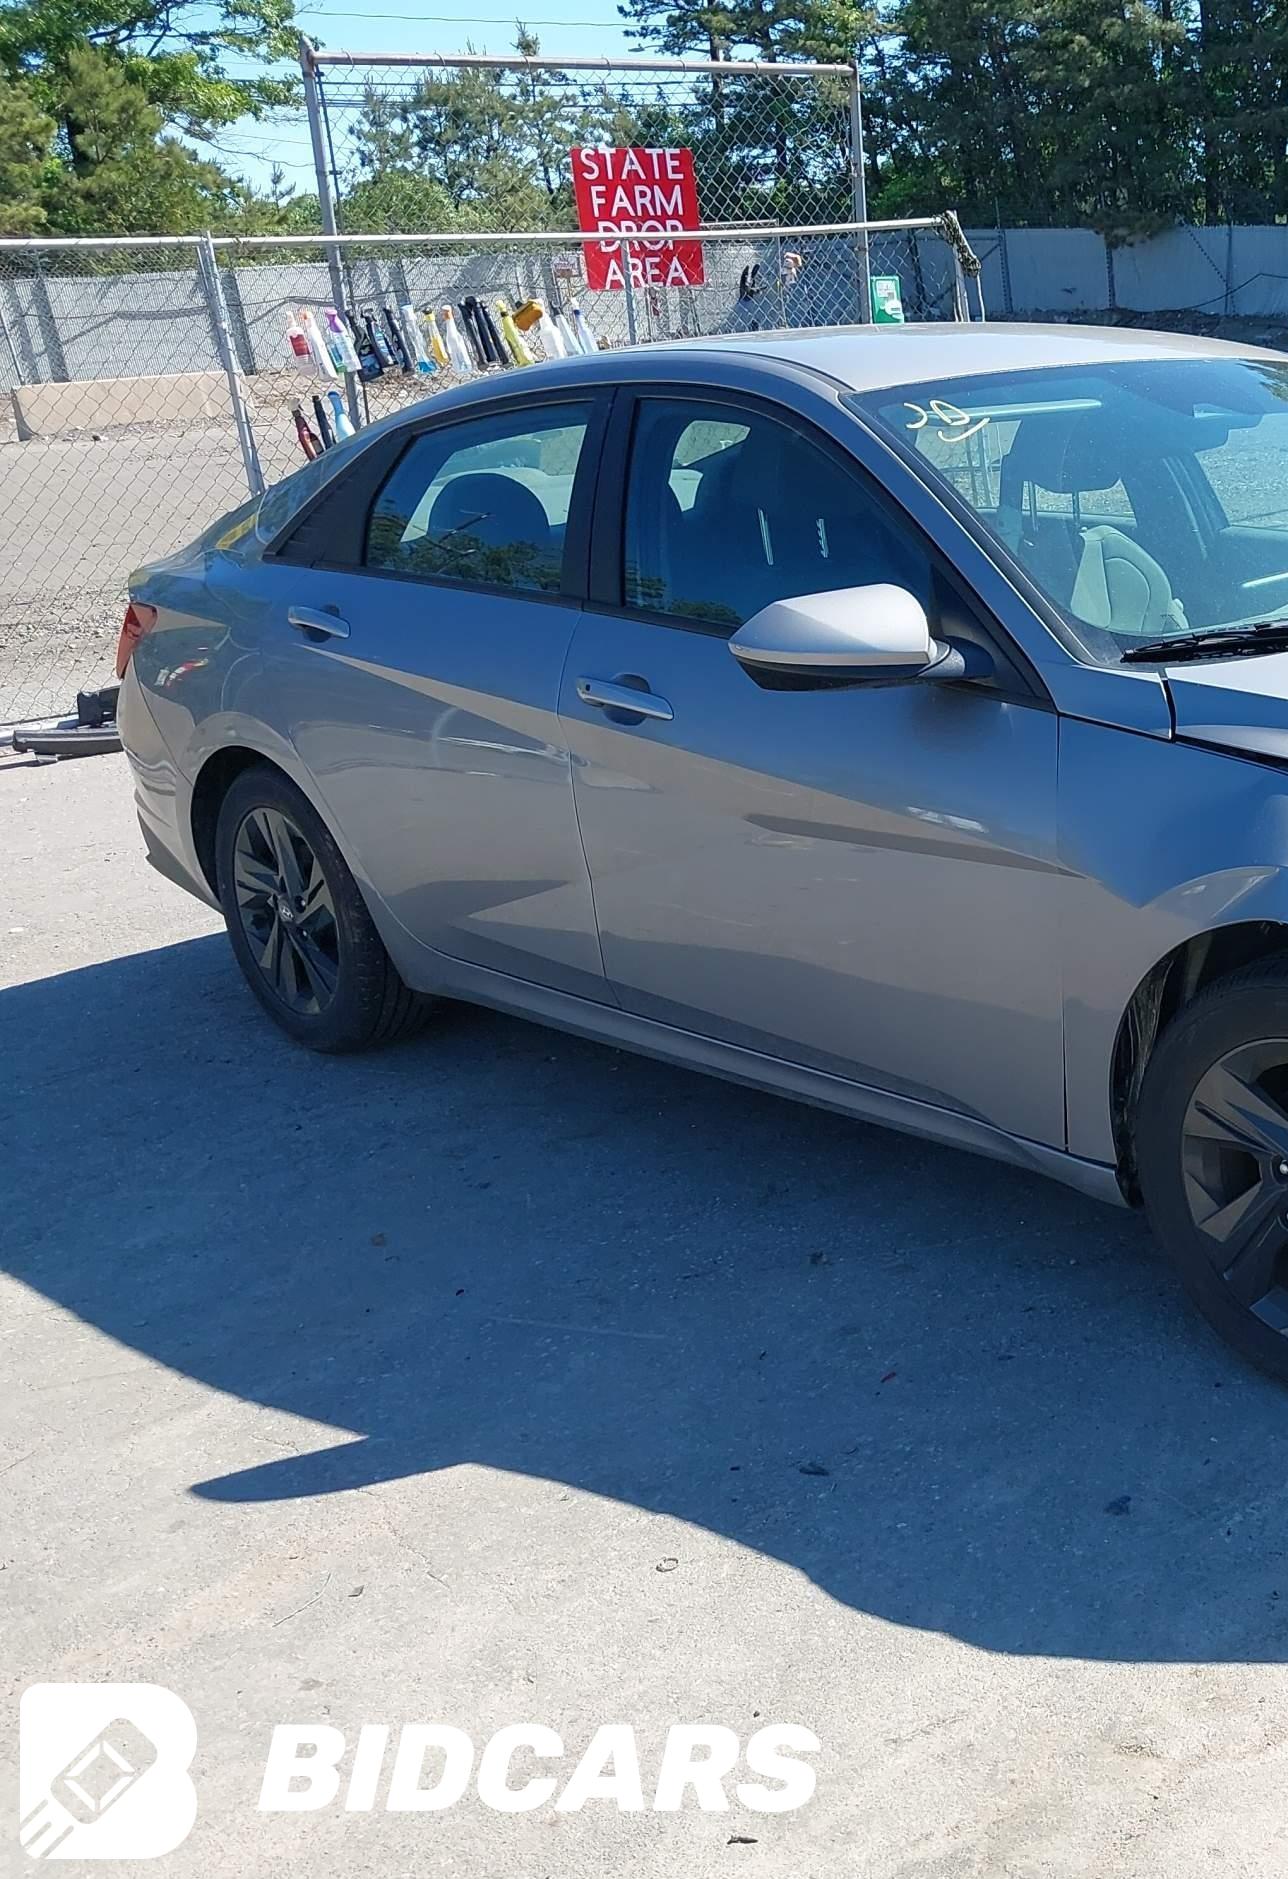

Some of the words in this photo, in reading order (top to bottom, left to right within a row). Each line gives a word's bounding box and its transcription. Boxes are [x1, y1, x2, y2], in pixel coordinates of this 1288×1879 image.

[580, 149, 684, 180] STATE
[591, 184, 683, 217] FARM
[605, 256, 690, 290] AREA
